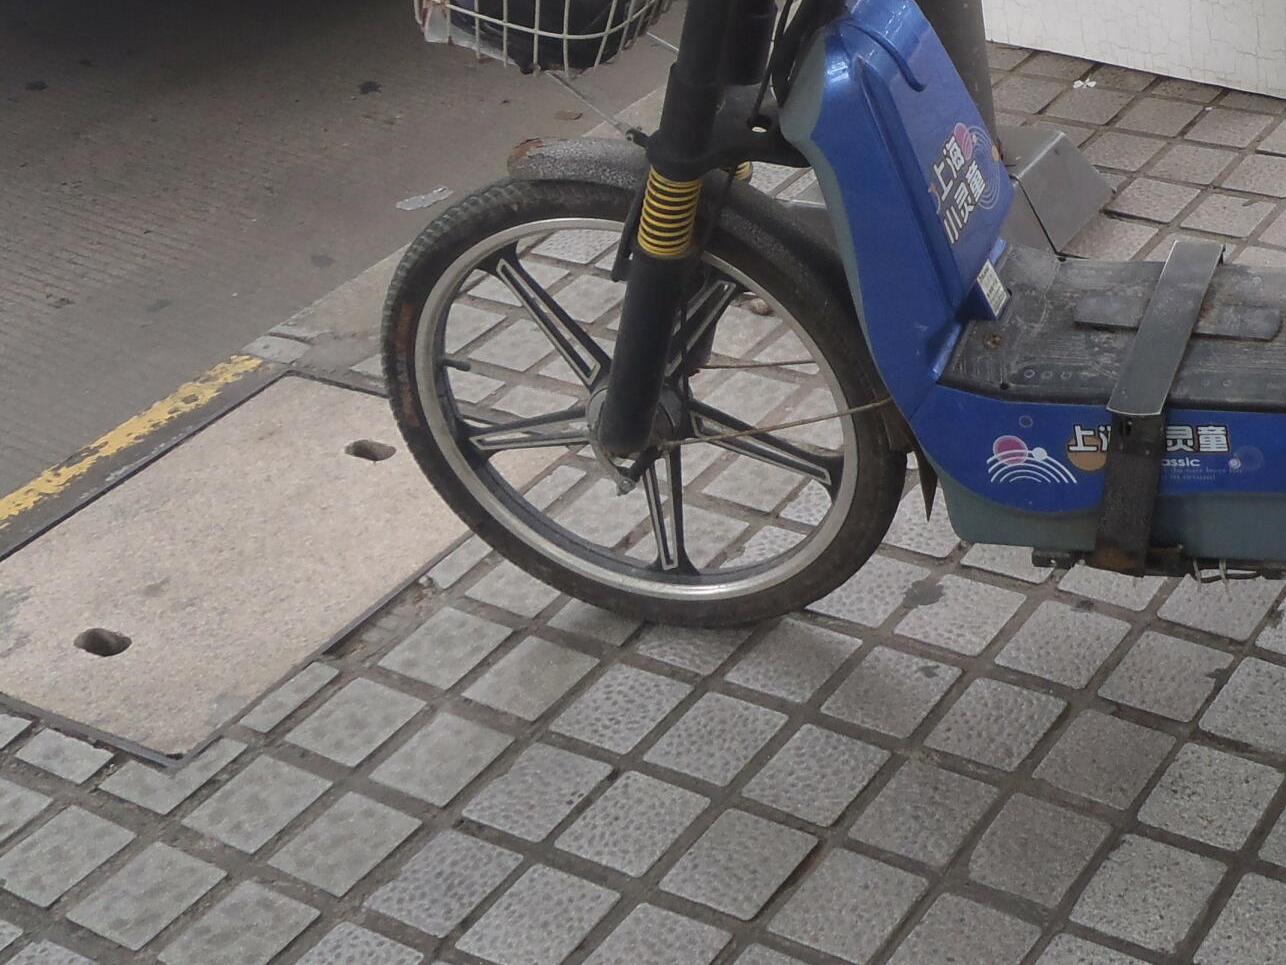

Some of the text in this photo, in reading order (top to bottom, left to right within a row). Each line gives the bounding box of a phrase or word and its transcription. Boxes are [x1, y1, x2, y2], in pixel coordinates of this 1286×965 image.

[933, 135, 965, 202] 上海
[943, 160, 986, 245] 小灵童
[1161, 457, 1201, 468] assic
